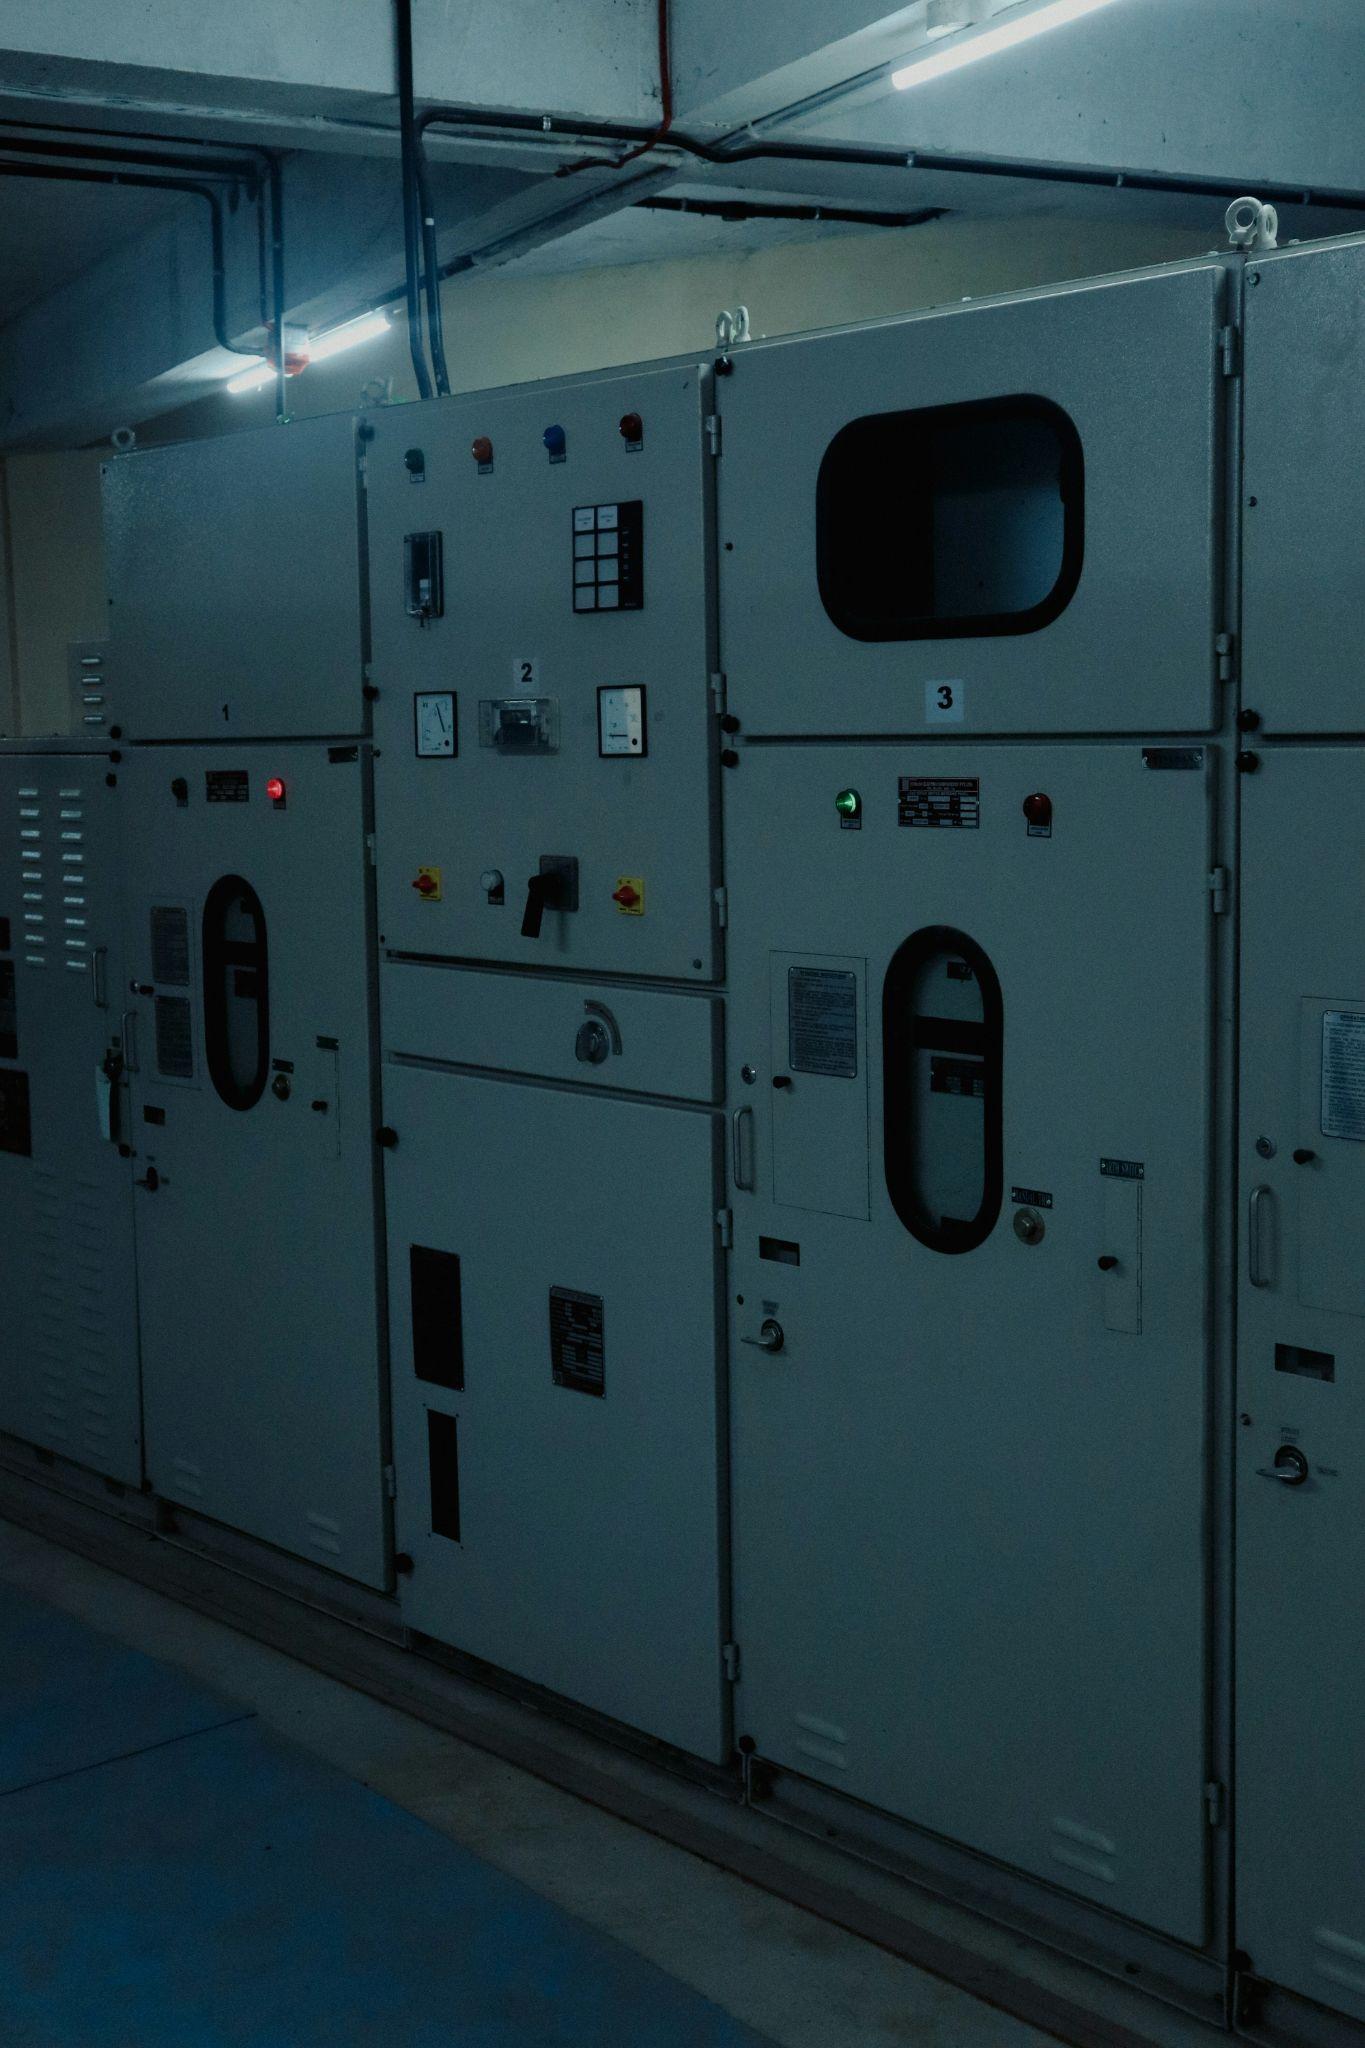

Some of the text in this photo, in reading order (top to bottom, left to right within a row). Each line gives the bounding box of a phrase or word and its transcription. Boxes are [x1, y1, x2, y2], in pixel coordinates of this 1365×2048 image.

[521, 662, 533, 683] 2
[937, 685, 953, 710] 3
[222, 703, 229, 721] 1
